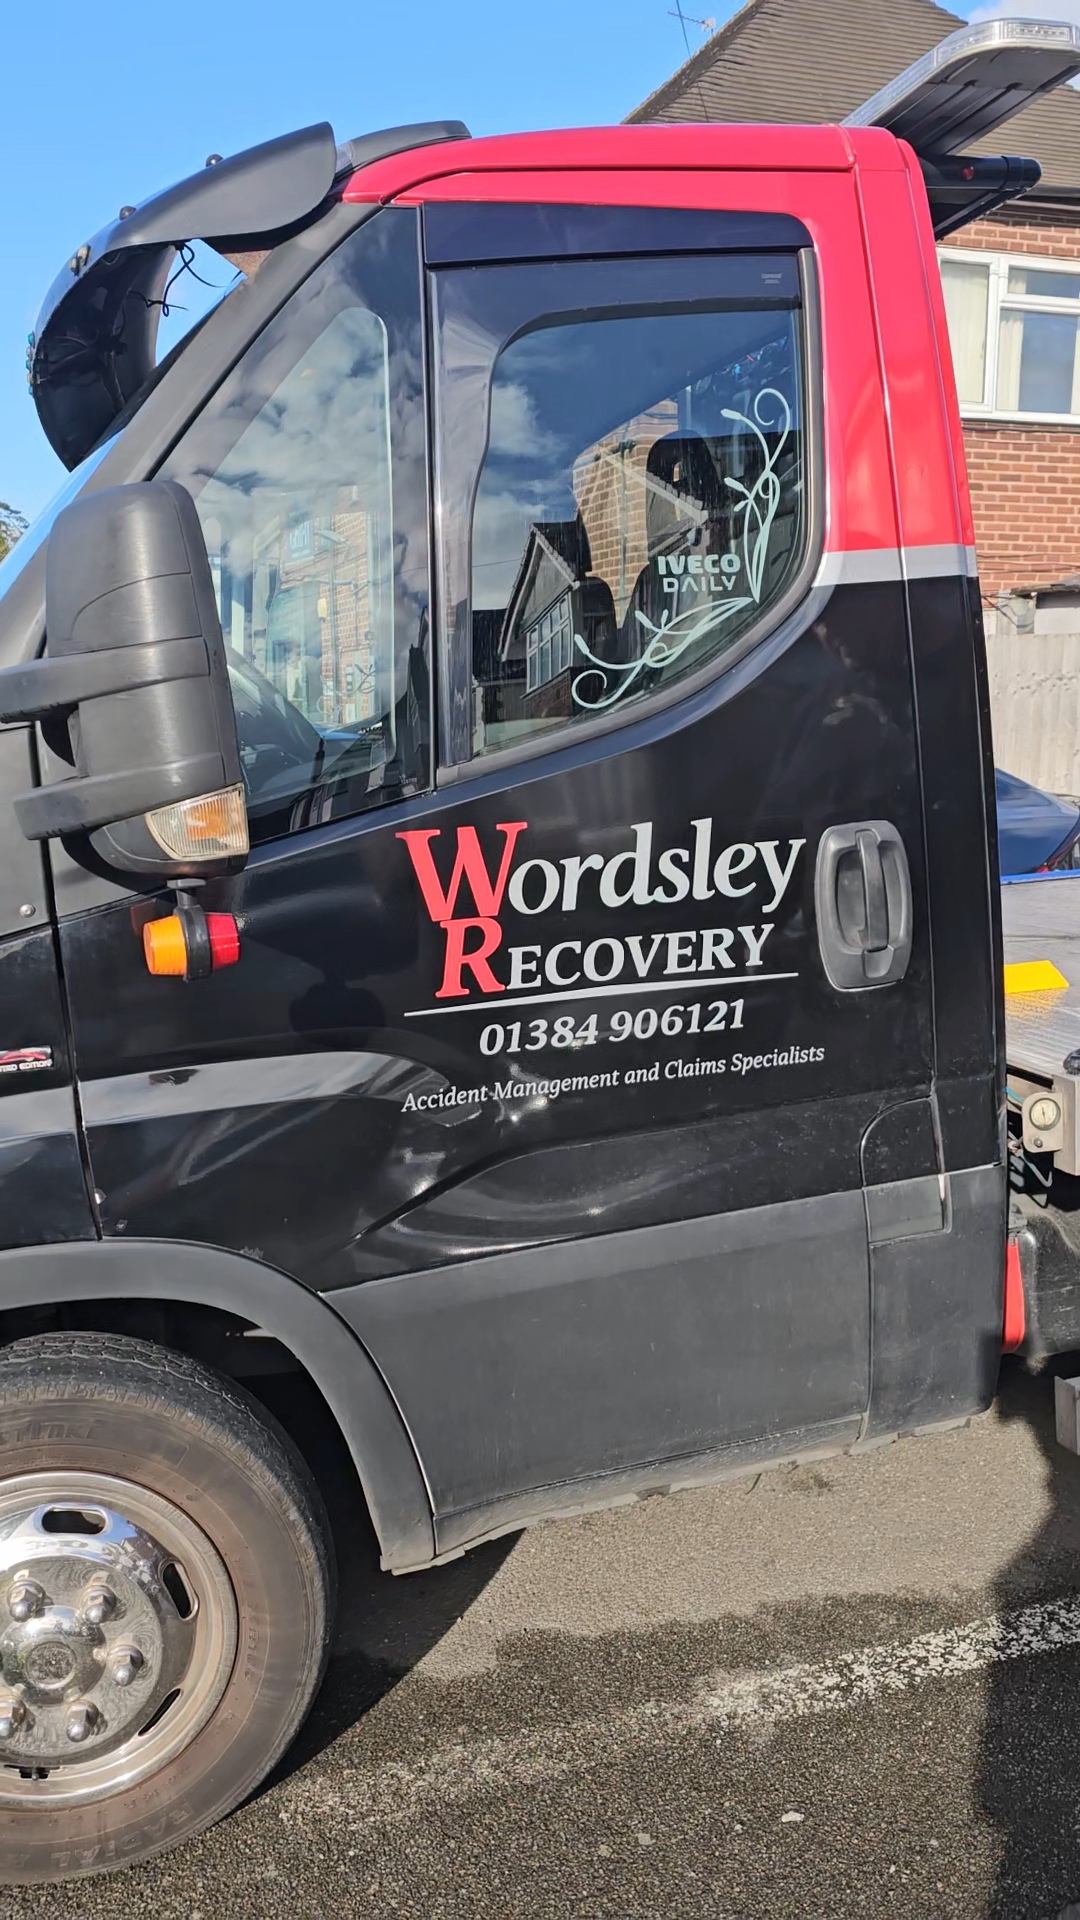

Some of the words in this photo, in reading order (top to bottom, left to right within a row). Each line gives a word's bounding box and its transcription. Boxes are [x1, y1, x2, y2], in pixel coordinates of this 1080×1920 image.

[657, 553, 741, 575] IVECO
[662, 575, 737, 593] DAILY
[395, 817, 807, 922] Wordsley
[435, 917, 775, 998] RECOVERY
[479, 1013, 599, 1056] 01384
[608, 998, 745, 1042] 906121
[401, 1083, 490, 1113] Accident
[494, 1070, 620, 1100] Management
[623, 1062, 660, 1085] and
[664, 1056, 726, 1079] Claims
[730, 1045, 826, 1076] Specialists
